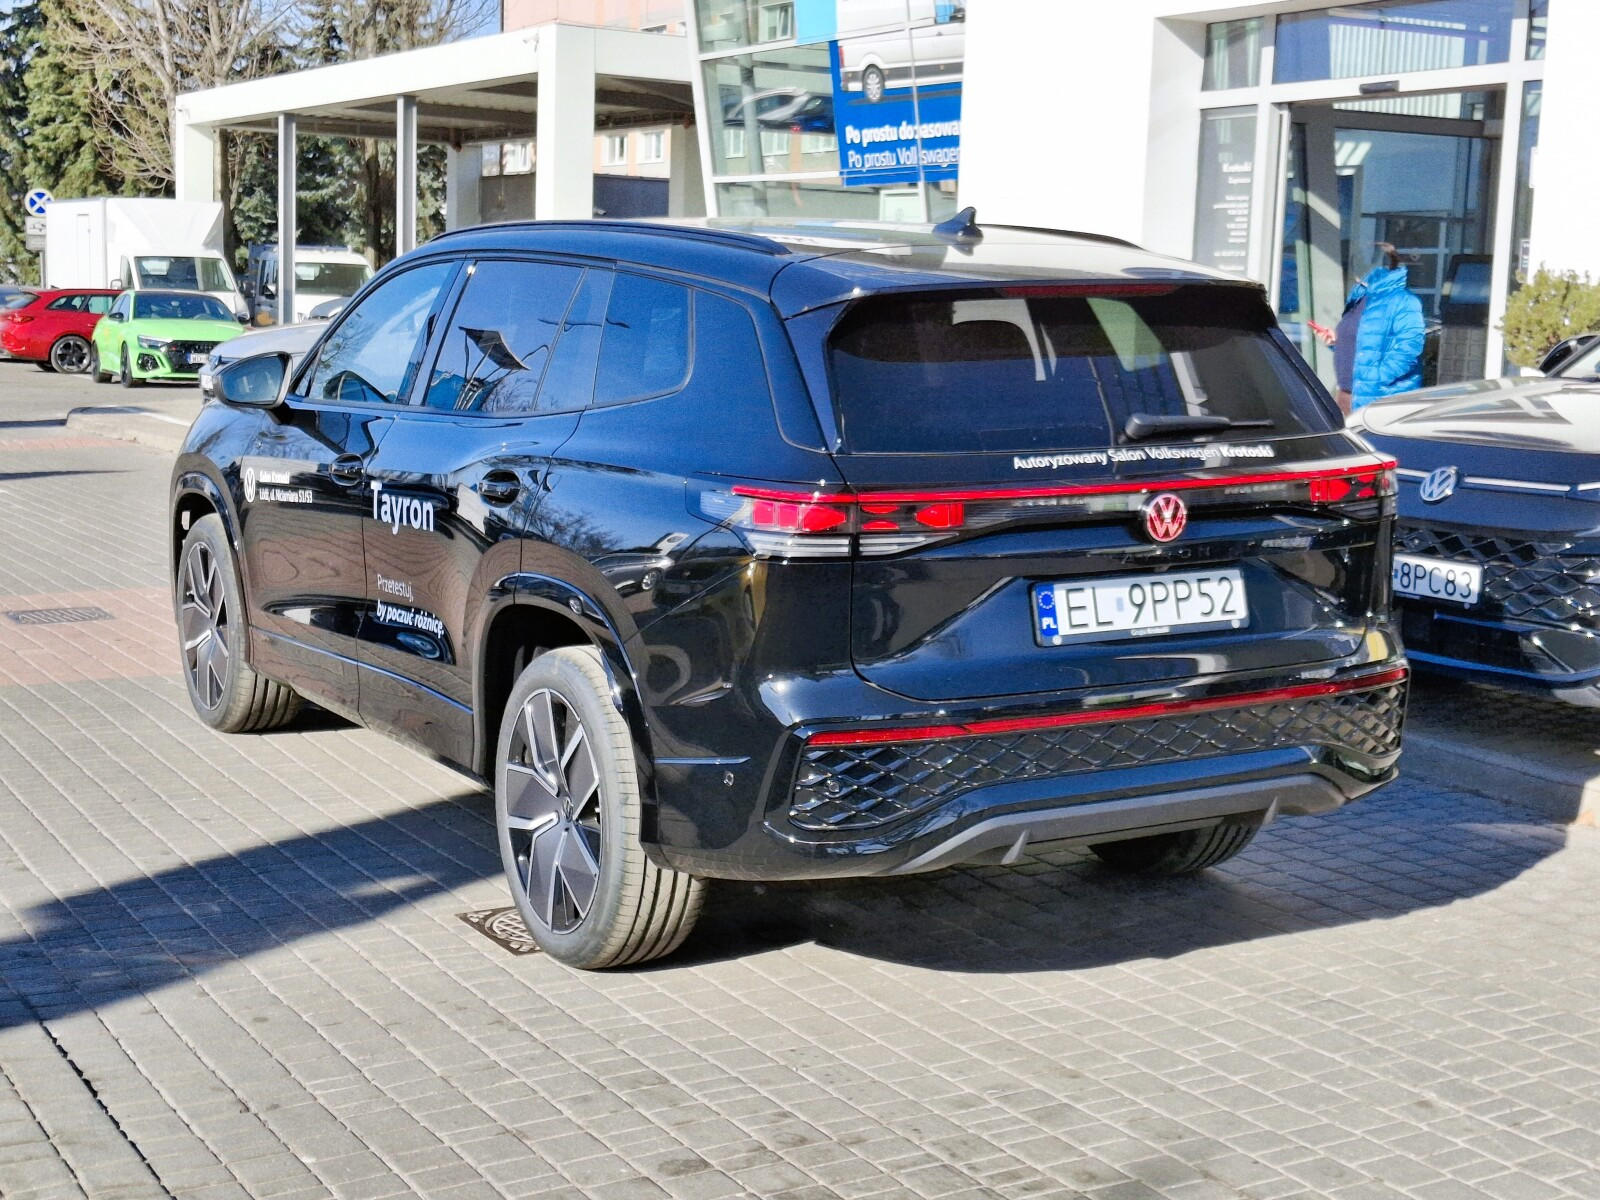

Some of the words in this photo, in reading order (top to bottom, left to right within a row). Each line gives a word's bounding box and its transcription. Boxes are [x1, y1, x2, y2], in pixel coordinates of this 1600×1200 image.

[845, 124, 860, 144] Po
[861, 124, 898, 147] prostu
[848, 150, 862, 168] Po
[864, 150, 896, 172] prostu
[1013, 452, 1107, 469] Autoryzowany
[1107, 449, 1146, 462] Salon
[1145, 446, 1219, 461] Volkswagen
[1219, 444, 1274, 458] Krotoski
[370, 480, 434, 535] Tayron
[377, 574, 414, 602] Przetestuj,
[1400, 562, 1472, 598] 8PC83
[1065, 587, 1113, 629] EL
[1128, 576, 1236, 624] 9PP52
[376, 598, 386, 622] by
[386, 606, 414, 626] poczuć
[414, 610, 444, 639] różnicę.
[1042, 617, 1057, 630] PL
